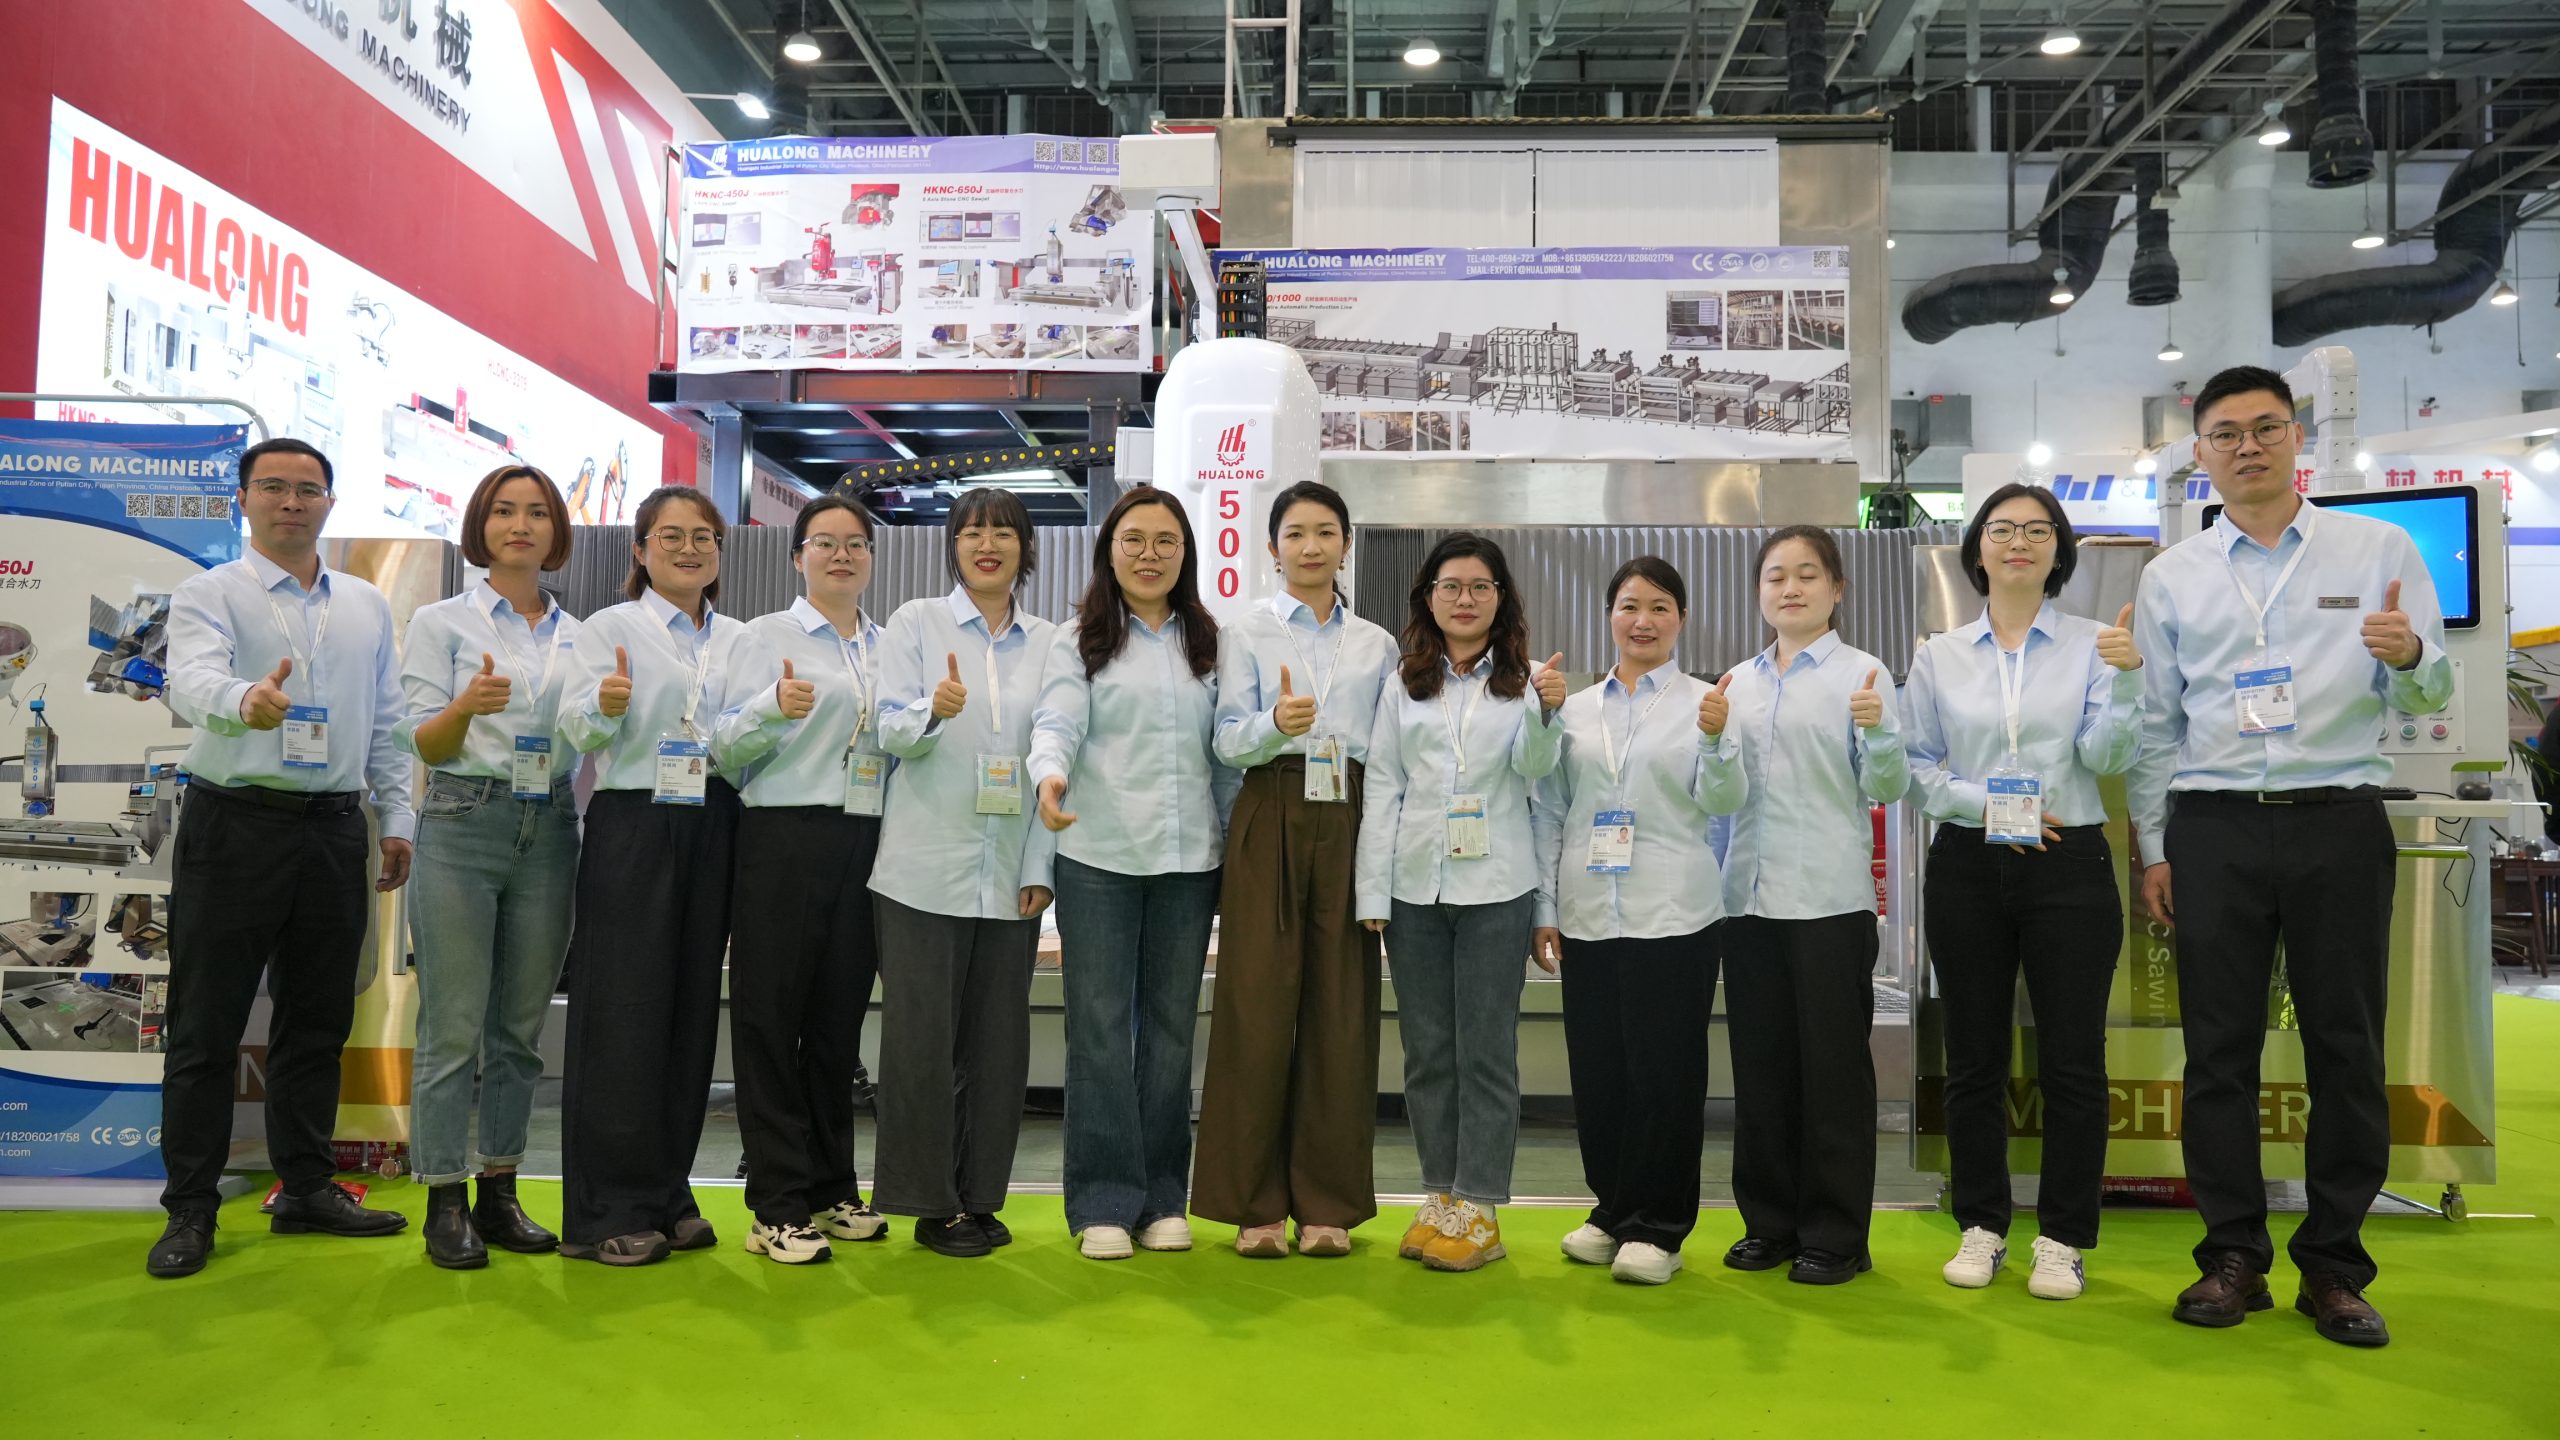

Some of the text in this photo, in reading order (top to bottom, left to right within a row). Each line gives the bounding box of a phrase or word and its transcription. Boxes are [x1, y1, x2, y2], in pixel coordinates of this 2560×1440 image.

[361, 28, 471, 132] MACHINERY
[737, 145, 932, 163] HUALONG MACHINERY
[694, 189, 750, 200] HKNC-450J
[923, 185, 983, 195] HKNC-650J
[69, 136, 310, 336] HUALONG
[1265, 253, 1448, 269] HUALONG MACHINERY
[89, 456, 230, 477] MACHINERY
[1198, 469, 1265, 480] HUALONG
[56, 480, 77, 488] Putian
[0, 1131, 80, 1143] /18206021758
